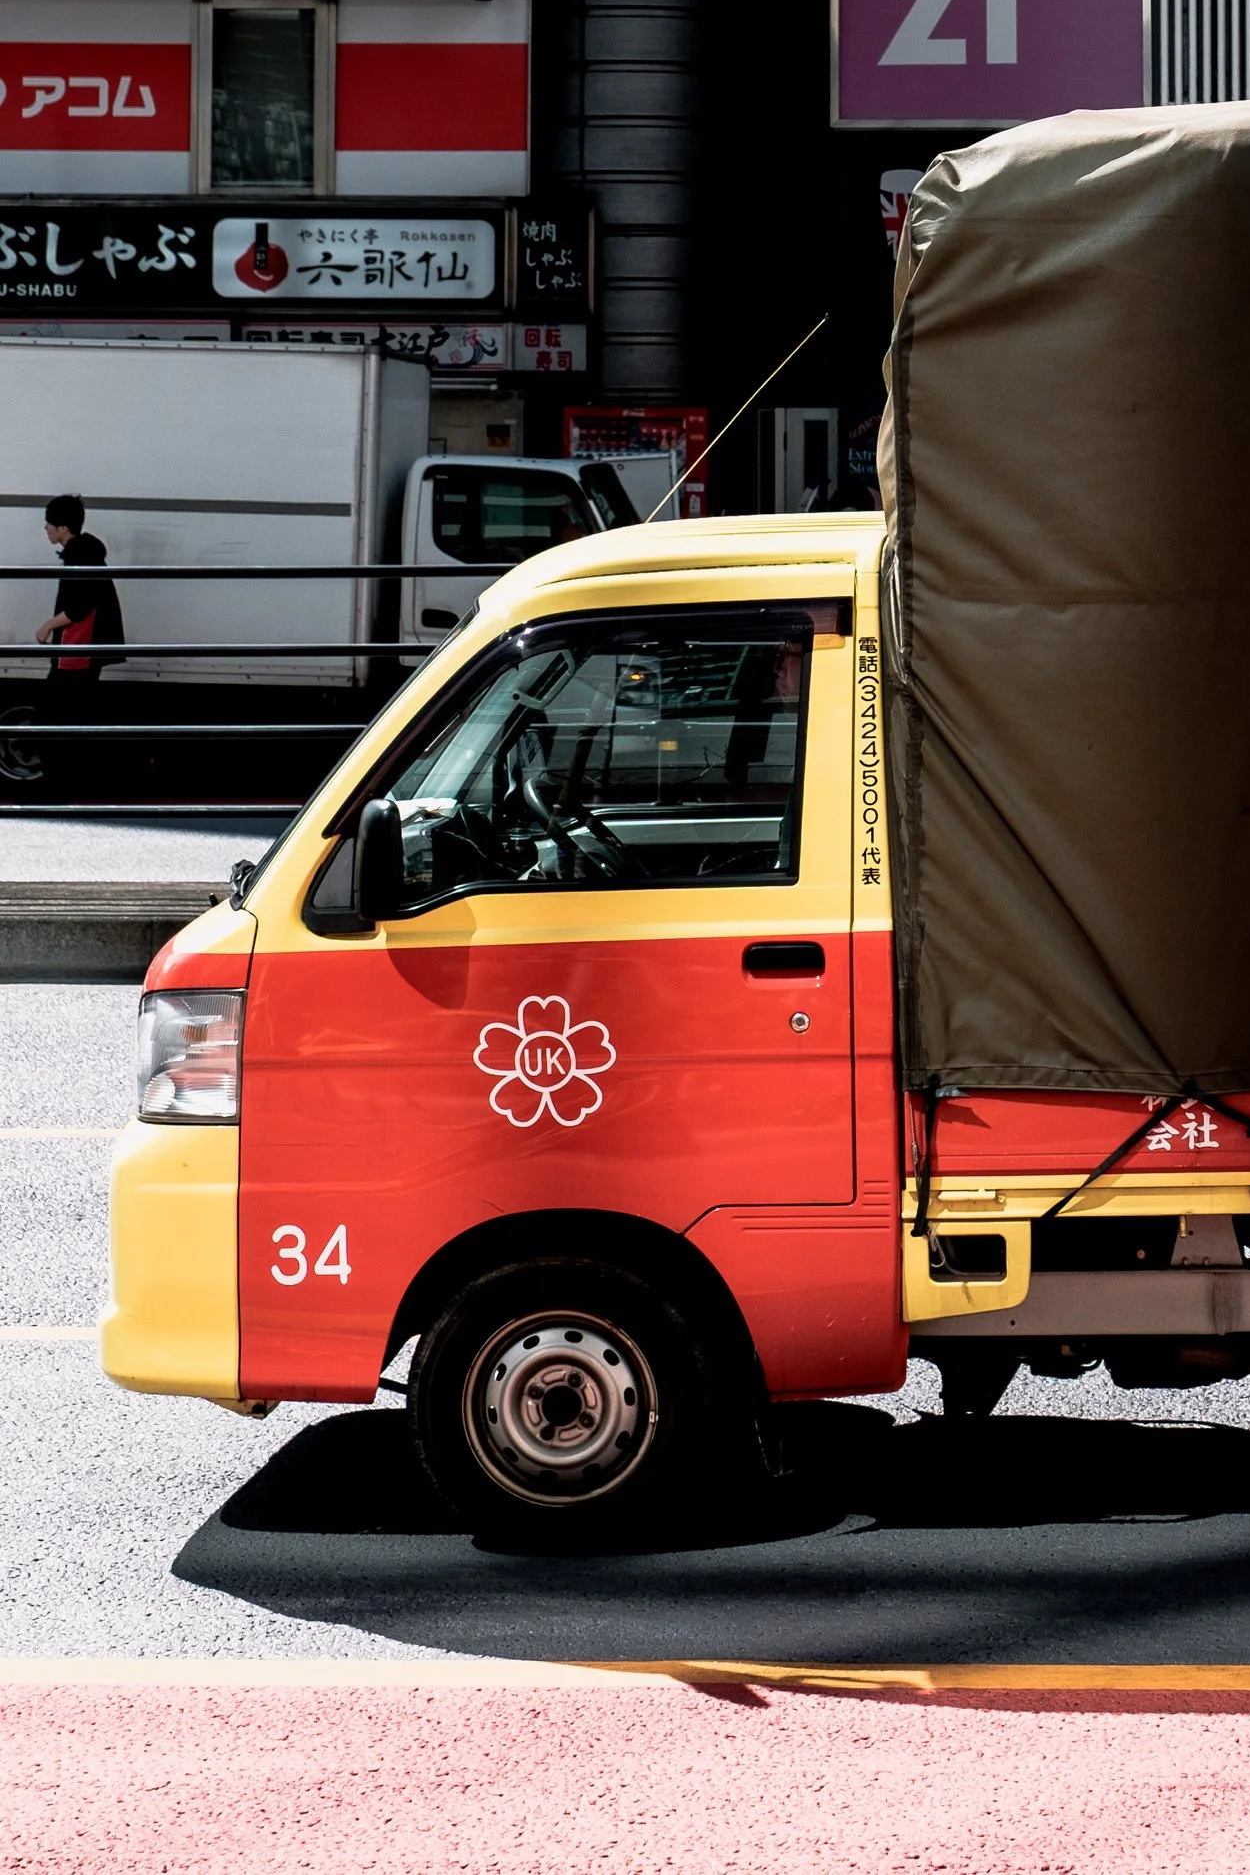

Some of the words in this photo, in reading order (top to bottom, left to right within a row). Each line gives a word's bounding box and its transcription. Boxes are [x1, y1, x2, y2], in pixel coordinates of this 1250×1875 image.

[21, 75, 157, 119] アコム
[297, 228, 380, 246] やきにく亭
[399, 230, 477, 243] Rokkasen
[522, 220, 557, 243] 焼肉
[525, 247, 573, 267] しゃぶ
[535, 270, 584, 289] しゃぶ
[525, 328, 562, 348] 回転
[536, 351, 572, 372] 寿司
[523, 1047, 567, 1077] UK
[1145, 1111, 1221, 1152] 会社
[270, 1223, 353, 1286] 34
